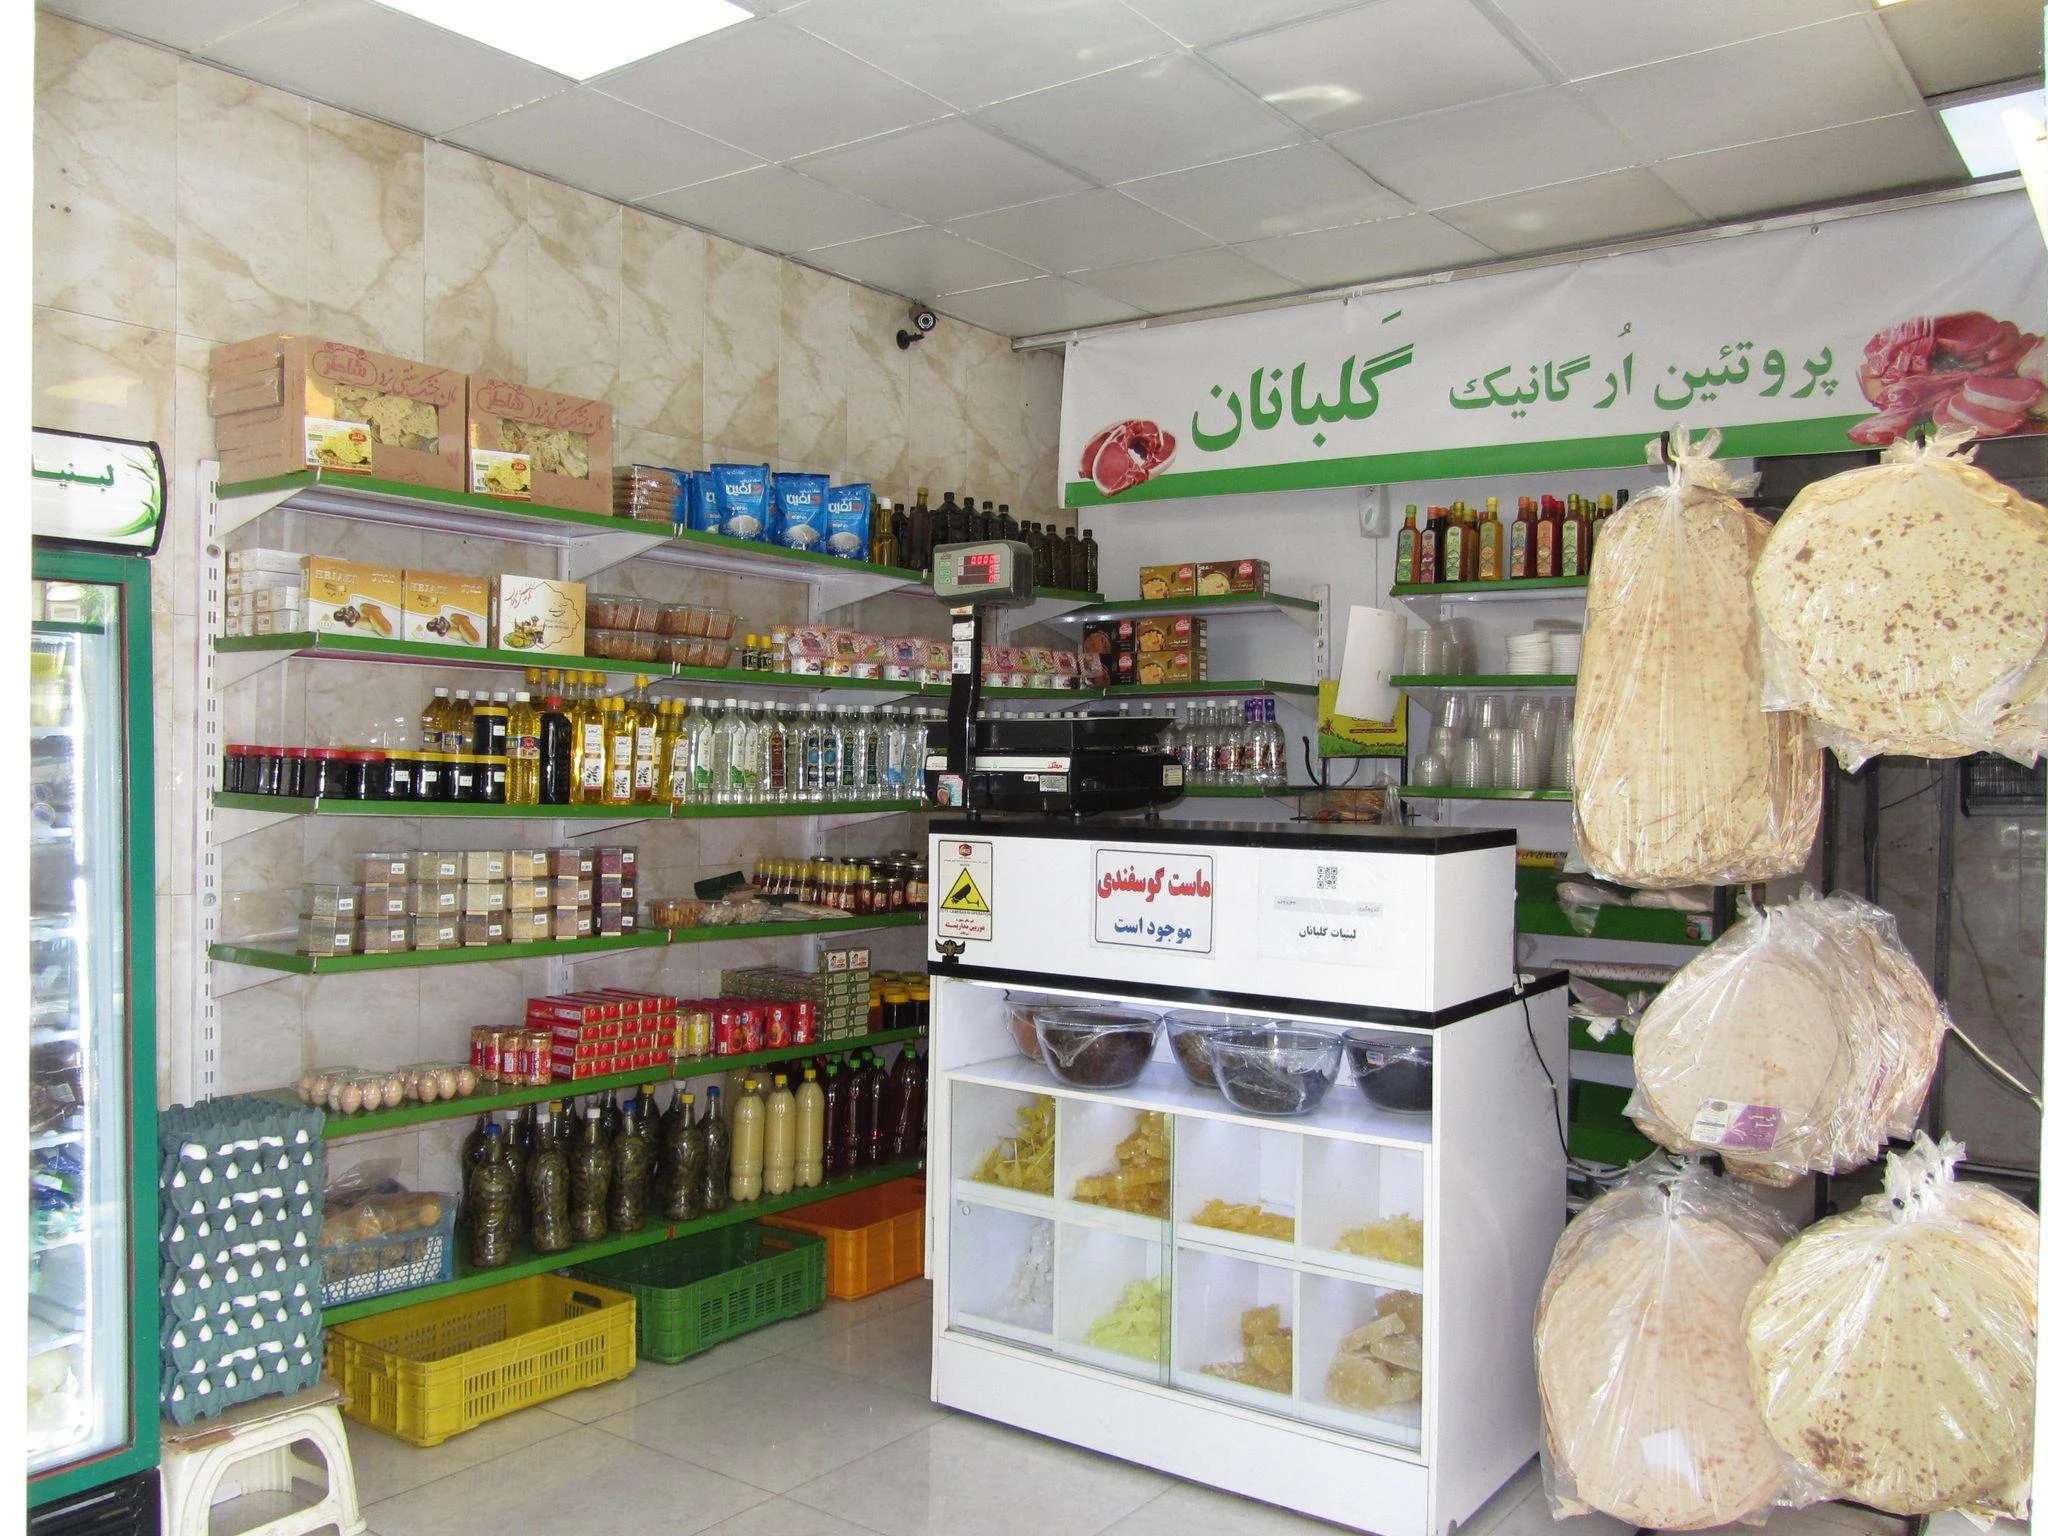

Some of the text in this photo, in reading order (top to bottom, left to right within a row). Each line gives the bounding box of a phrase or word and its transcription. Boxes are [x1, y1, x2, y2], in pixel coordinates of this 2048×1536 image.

[1652, 335, 1839, 410] پروتئین
[1097, 866, 1211, 903] ماست گوسفندی
[1113, 916, 1192, 944] موجود است
[1298, 925, 1357, 941] لبنیات گلبانان
